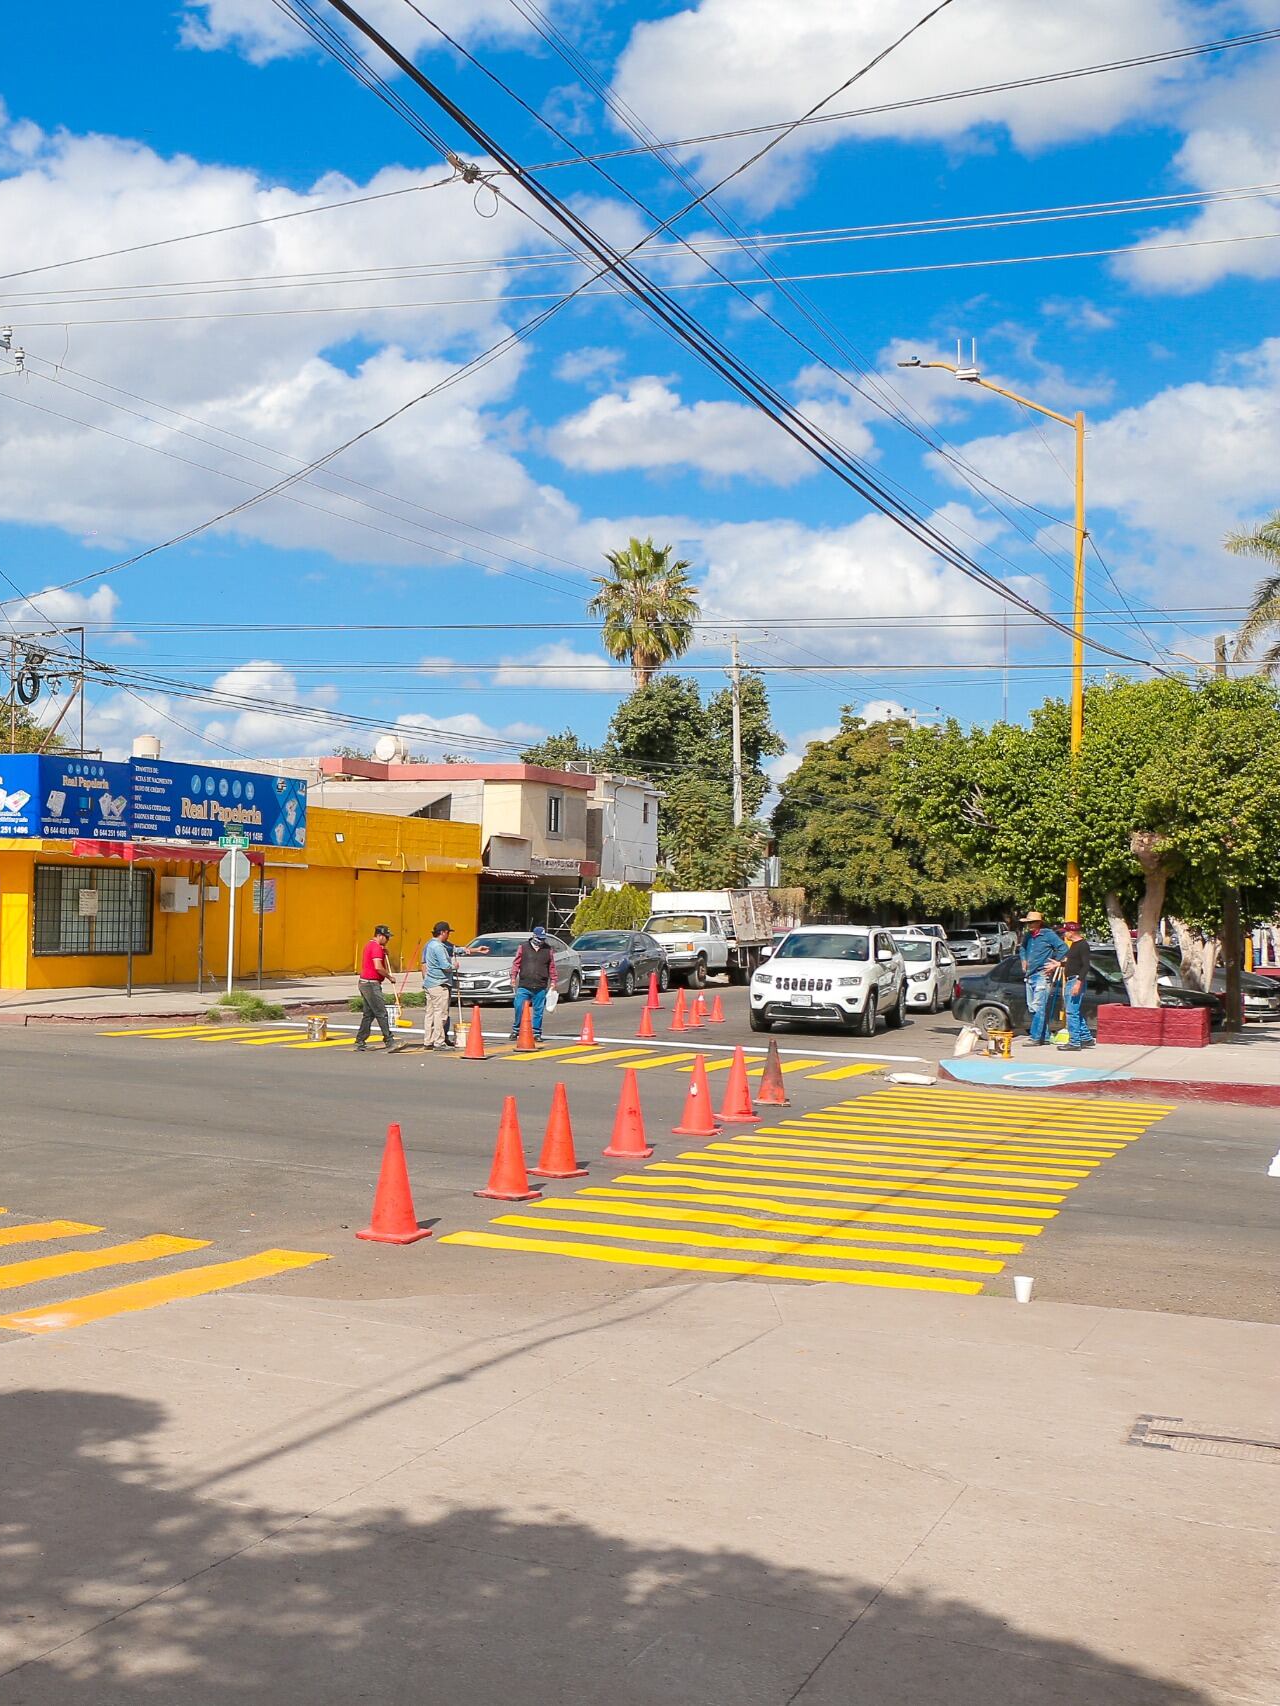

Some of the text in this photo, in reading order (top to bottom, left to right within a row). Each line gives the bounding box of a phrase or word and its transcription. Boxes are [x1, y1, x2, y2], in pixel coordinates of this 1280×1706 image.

[62, 775, 77, 788] Real
[181, 797, 208, 820] Real
[182, 826, 191, 835] 644
